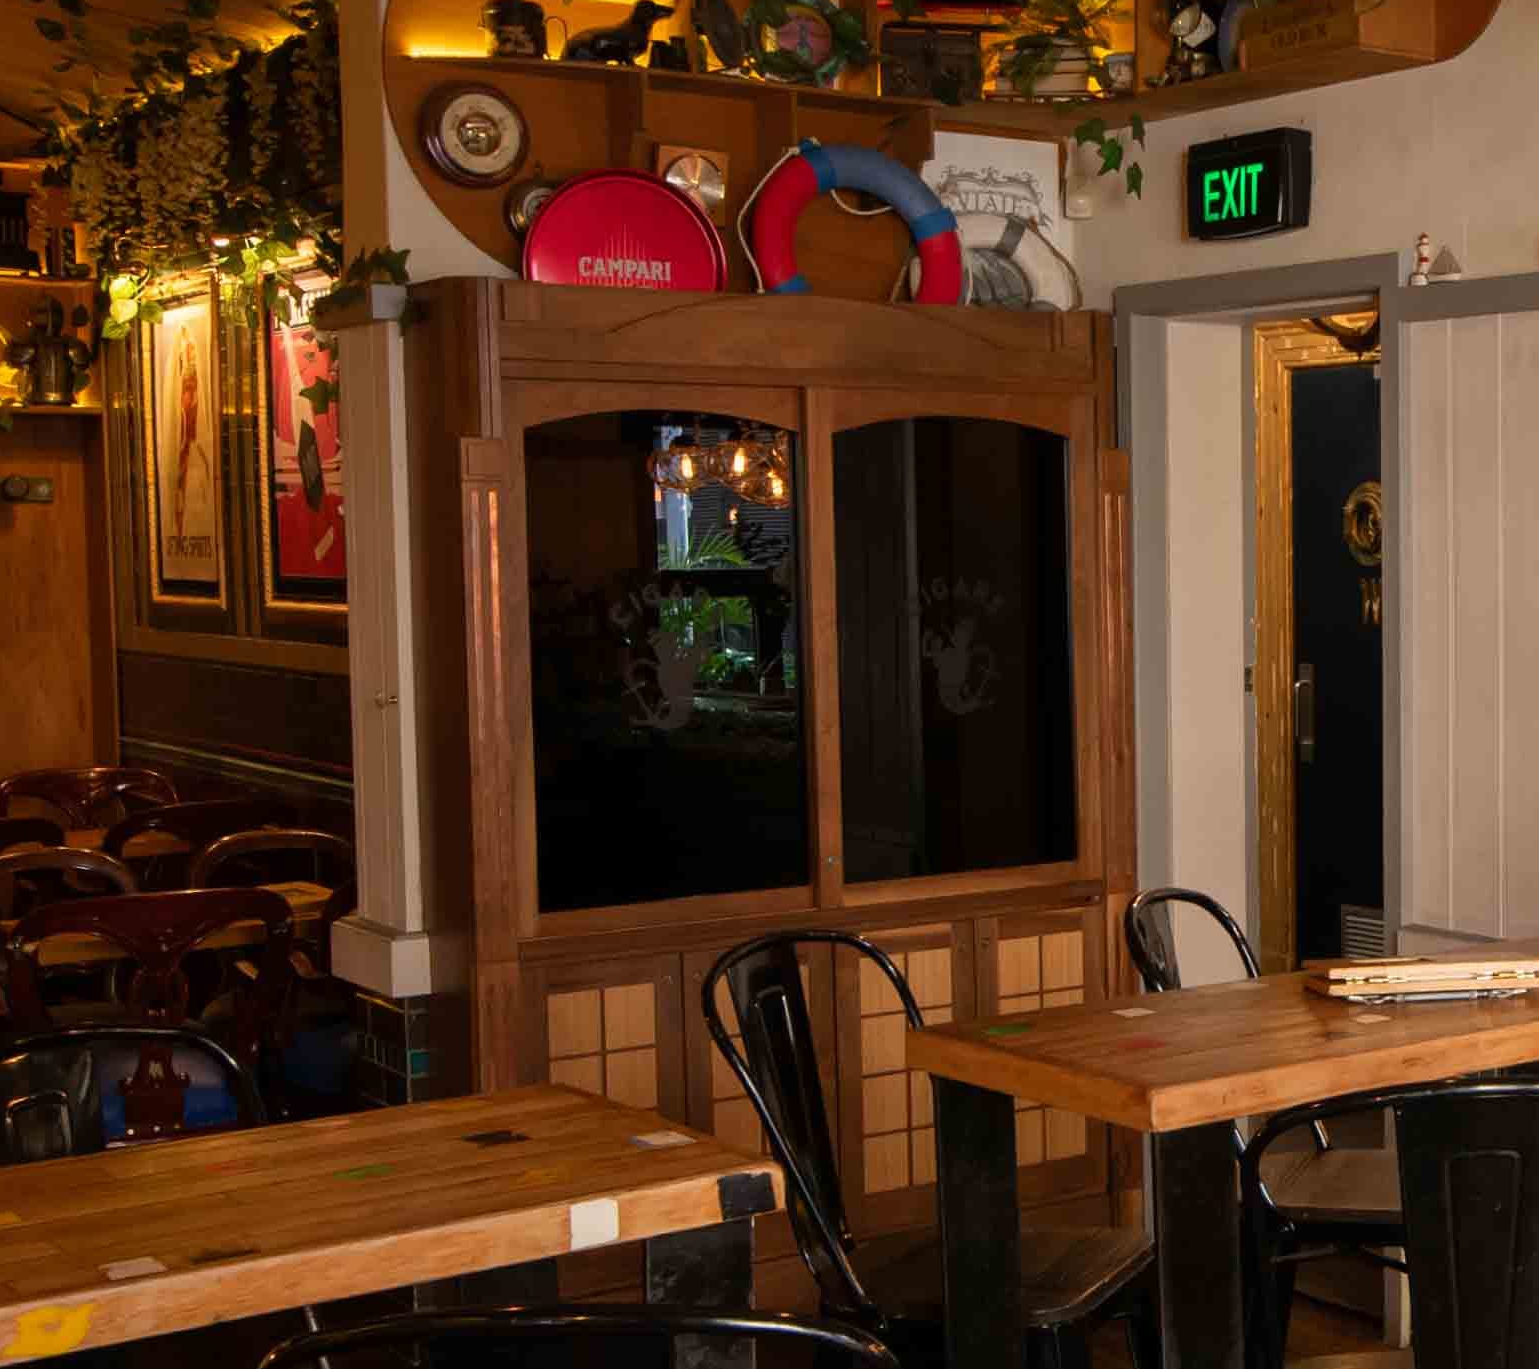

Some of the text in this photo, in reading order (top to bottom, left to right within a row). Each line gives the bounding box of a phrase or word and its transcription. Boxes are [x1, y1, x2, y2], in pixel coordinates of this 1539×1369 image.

[1204, 163, 1263, 222] EXIT
[578, 255, 672, 282] CAMPARI
[608, 581, 715, 628] CIGAR
